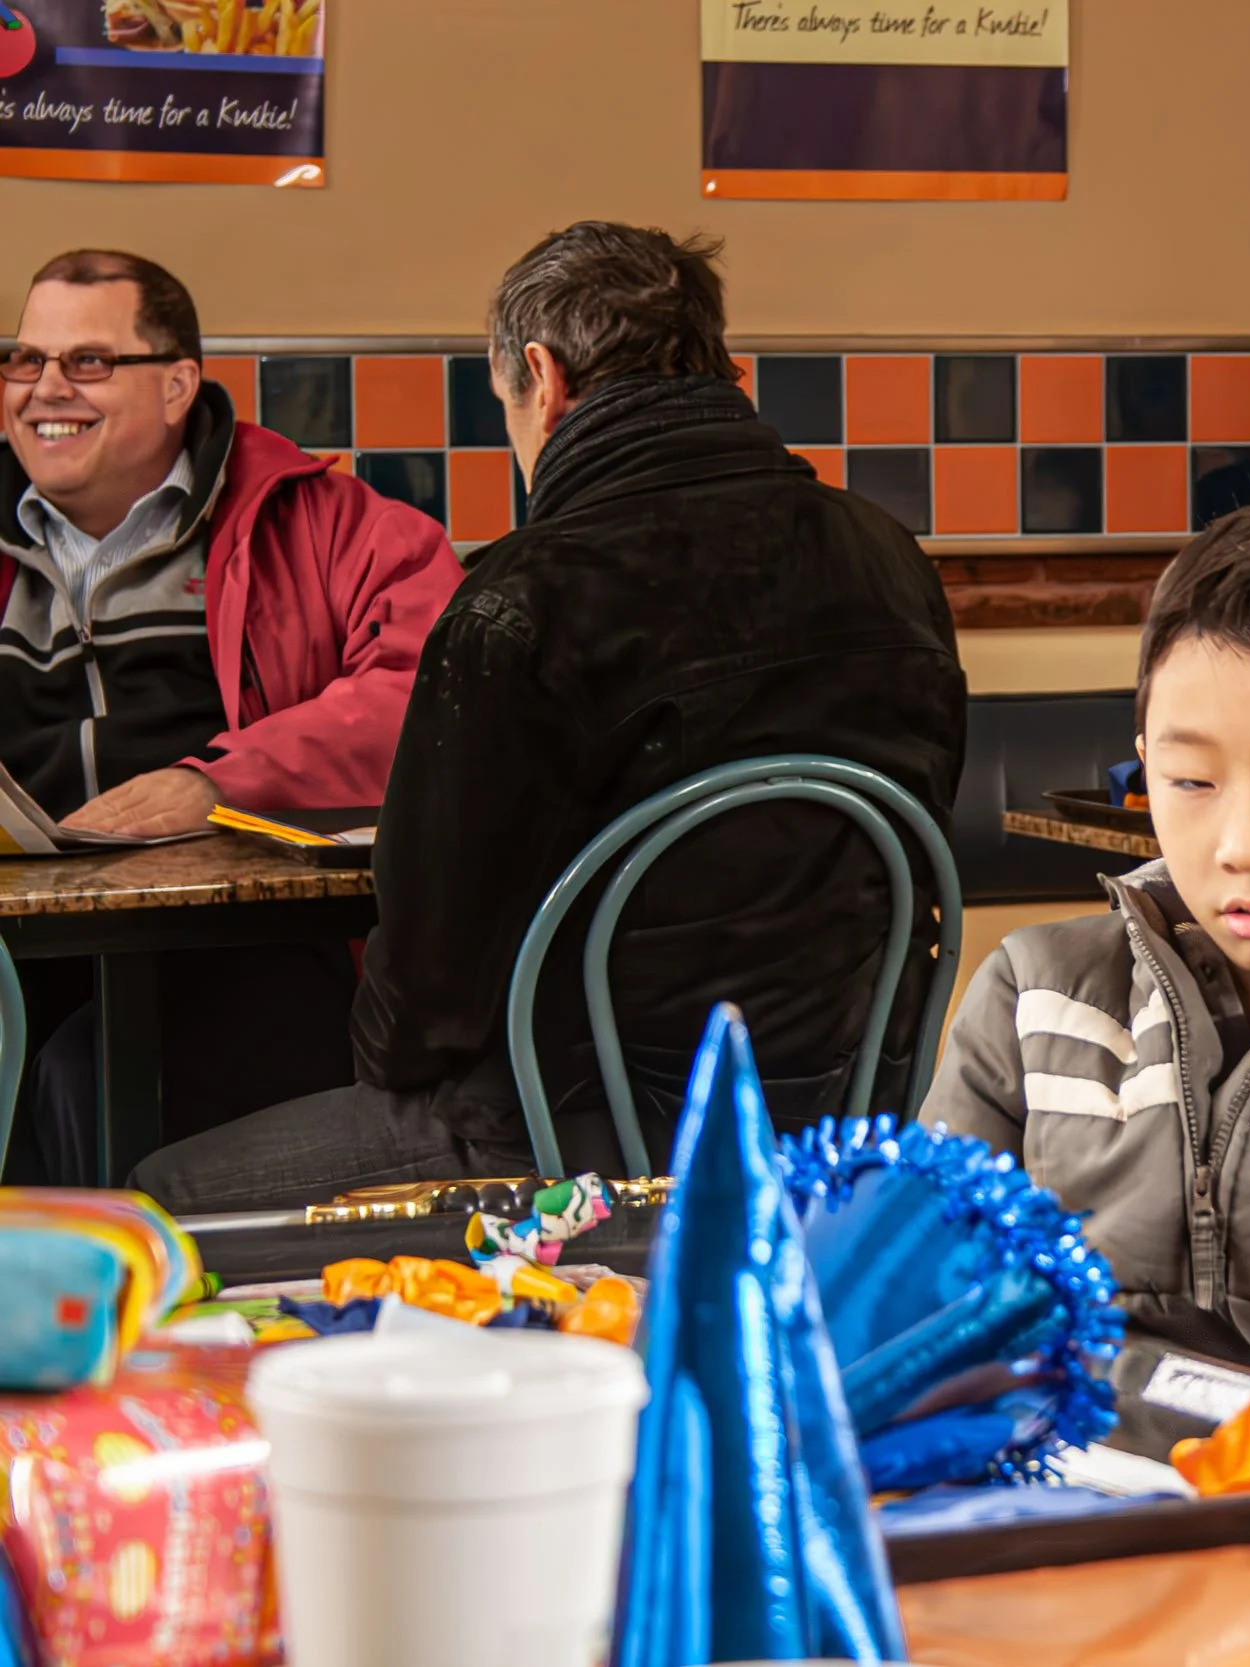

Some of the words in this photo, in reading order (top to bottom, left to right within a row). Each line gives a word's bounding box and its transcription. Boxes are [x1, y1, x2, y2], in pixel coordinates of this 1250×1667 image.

[797, 4, 861, 44] always
[870, 11, 917, 35] time
[920, 5, 951, 38] for
[955, 19, 968, 35] a
[23, 90, 94, 134] always
[103, 97, 154, 126] time
[158, 94, 192, 129] for
[195, 108, 209, 127] a
[216, 96, 298, 130] Kwikie!
